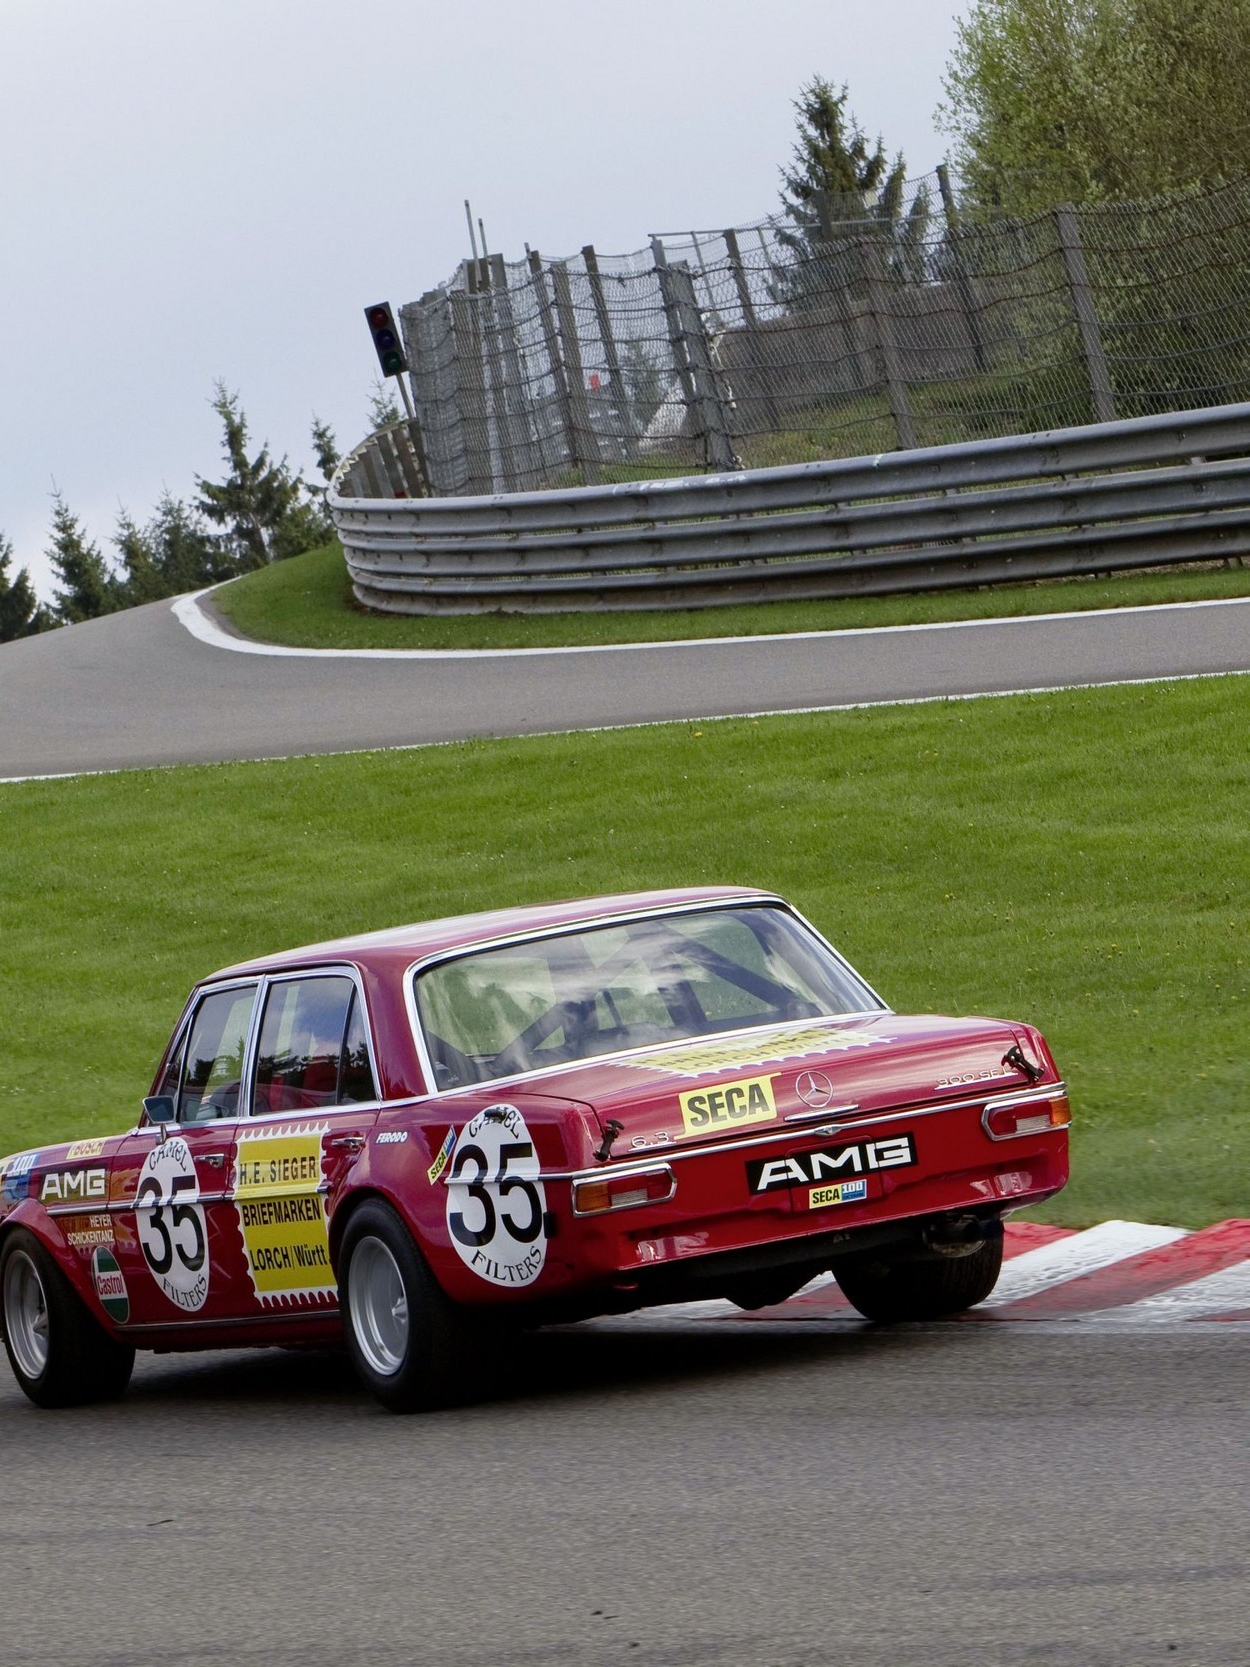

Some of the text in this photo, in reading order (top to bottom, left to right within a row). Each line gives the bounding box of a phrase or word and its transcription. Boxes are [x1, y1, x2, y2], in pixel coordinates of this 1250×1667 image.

[687, 1083, 770, 1127] SECA
[376, 1131, 408, 1144] FERODO
[270, 1156, 317, 1183] SIEGER
[431, 1151, 447, 1179] SECA
[757, 1137, 912, 1191] AMG
[41, 1168, 105, 1200] AMG
[450, 1142, 543, 1247] 35
[812, 1188, 840, 1204] SECA
[90, 1214, 112, 1227] HEYER
[137, 1175, 206, 1275] 35
[242, 1198, 321, 1227] BRIEFMARKEN
[67, 1230, 115, 1246] SCHICKENTANZ
[471, 1245, 542, 1282] FILTERS
[97, 1275, 125, 1296] Castrol
[163, 1273, 207, 1308] FILTERS
